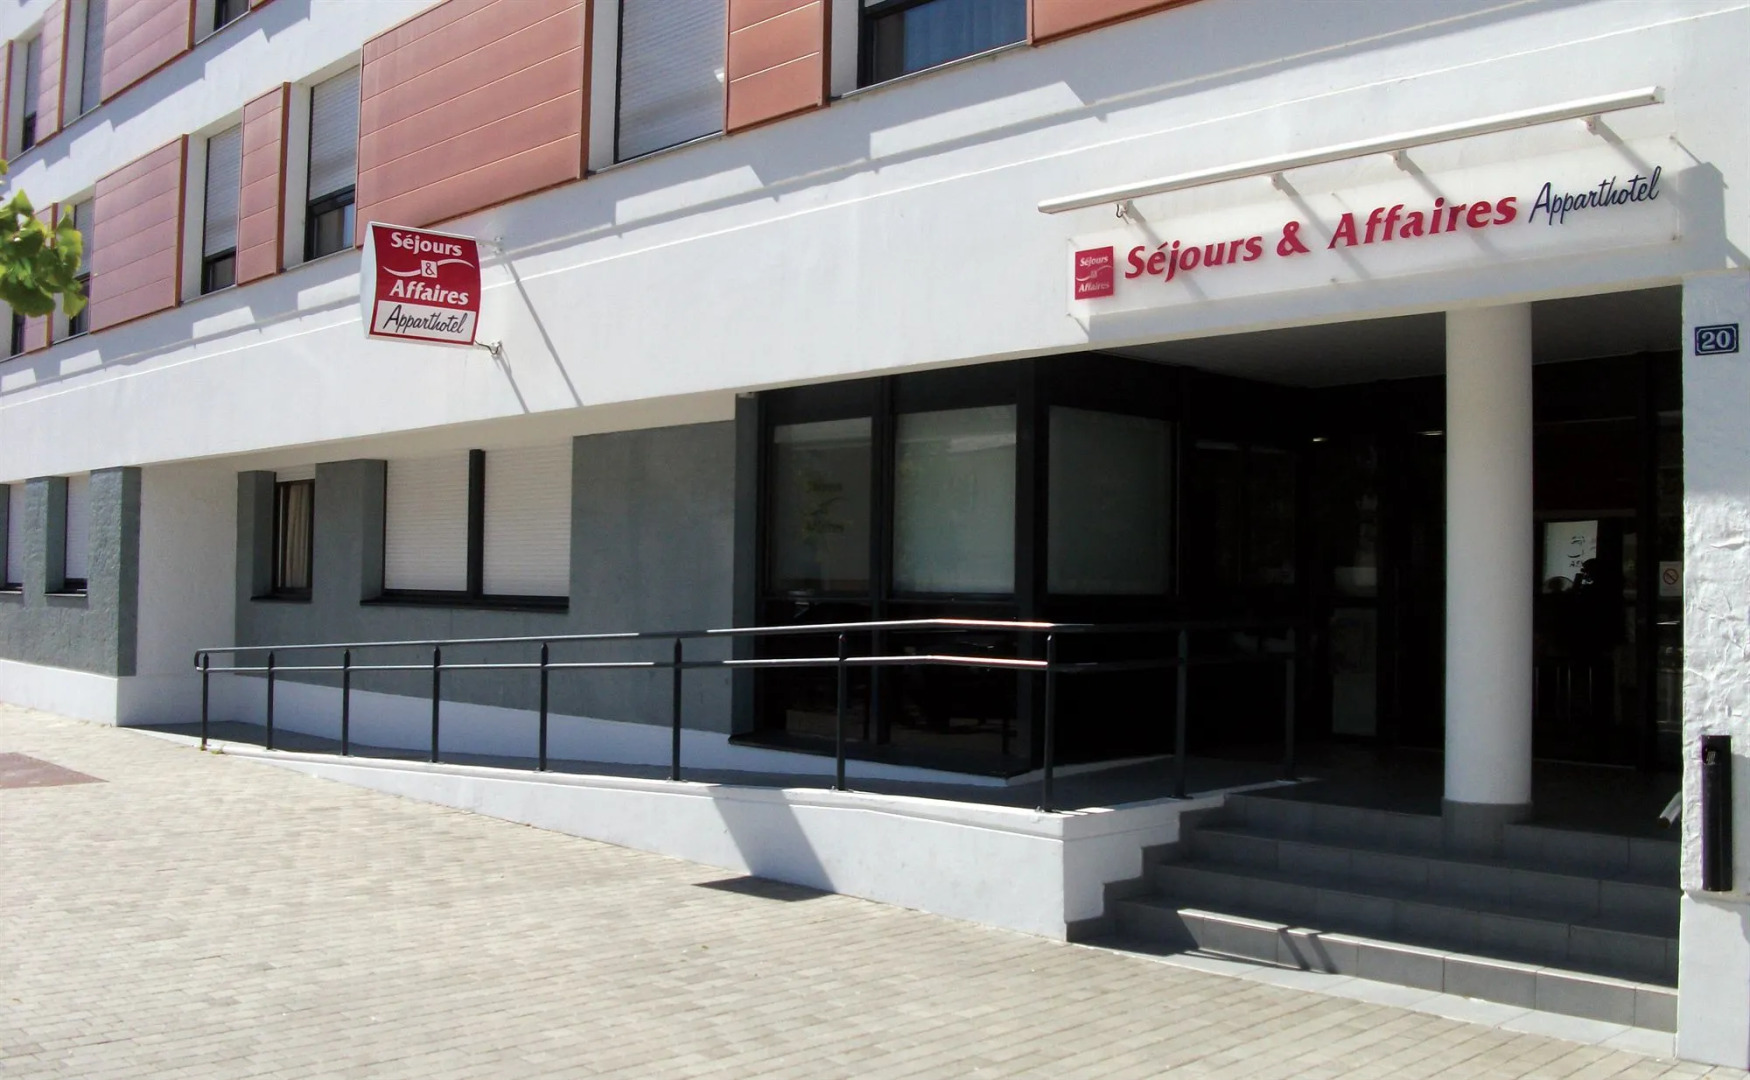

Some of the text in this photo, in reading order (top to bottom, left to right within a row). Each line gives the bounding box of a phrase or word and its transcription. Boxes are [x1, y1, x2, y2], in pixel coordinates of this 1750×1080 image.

[1125, 166, 1662, 283] Séjours & Affaires Apparthotel
[390, 232, 462, 257] Séjours
[425, 262, 435, 275] &
[389, 279, 469, 305] Affaires
[382, 304, 468, 333] Apparthotel
[1701, 330, 1731, 350] 20
